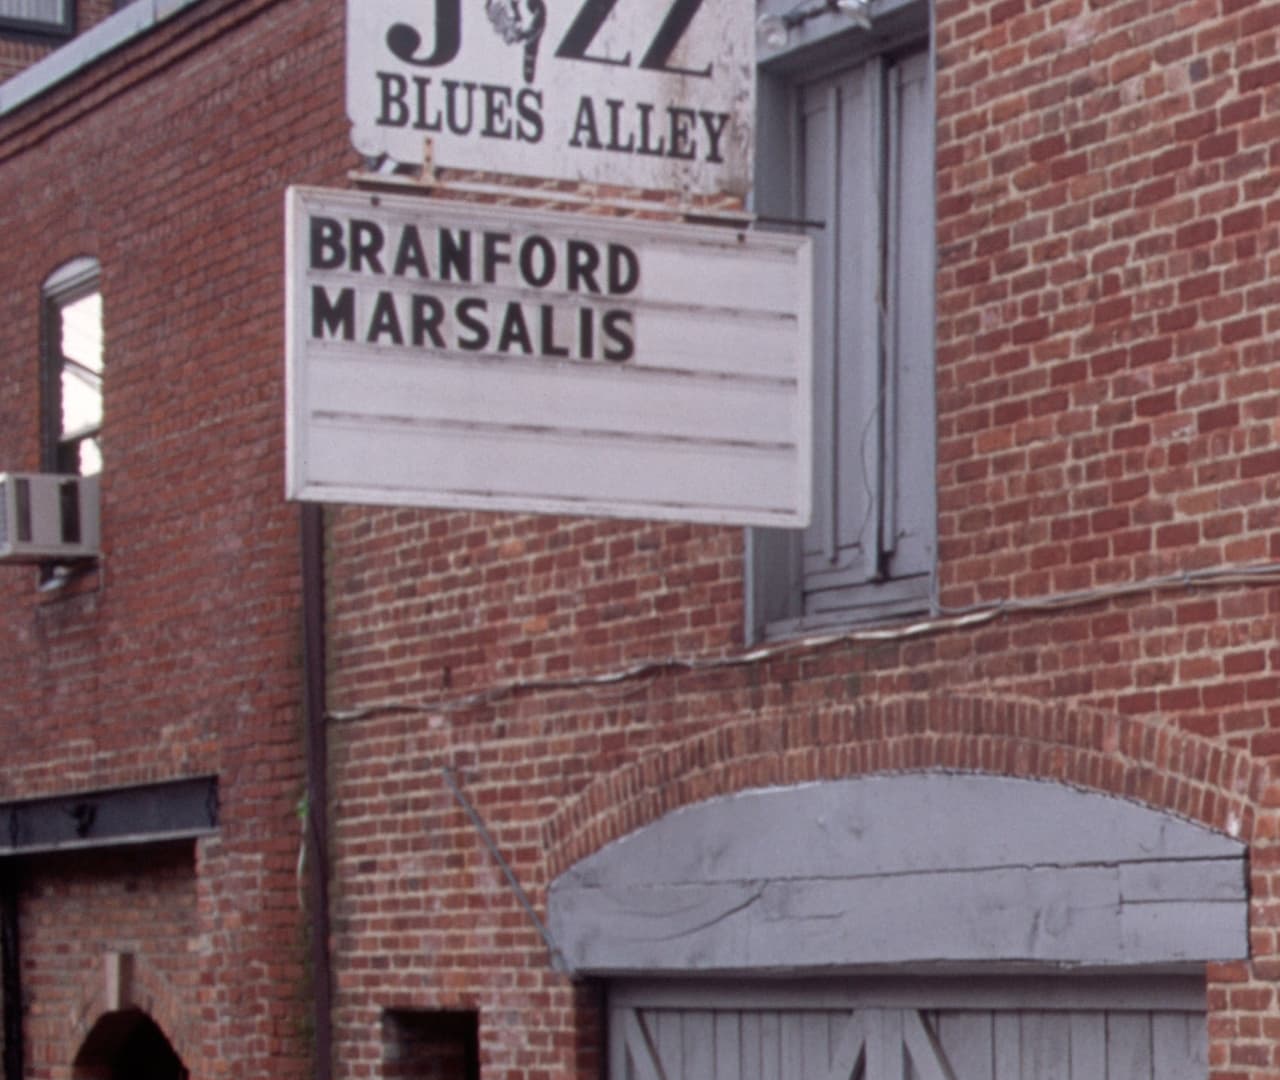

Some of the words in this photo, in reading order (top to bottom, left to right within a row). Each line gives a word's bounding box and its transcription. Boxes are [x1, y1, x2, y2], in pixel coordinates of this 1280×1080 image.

[375, 70, 545, 144] BLUES
[568, 96, 731, 164] ALLEY
[308, 215, 641, 295] BRANFORD
[310, 285, 637, 362] MARSALIS
